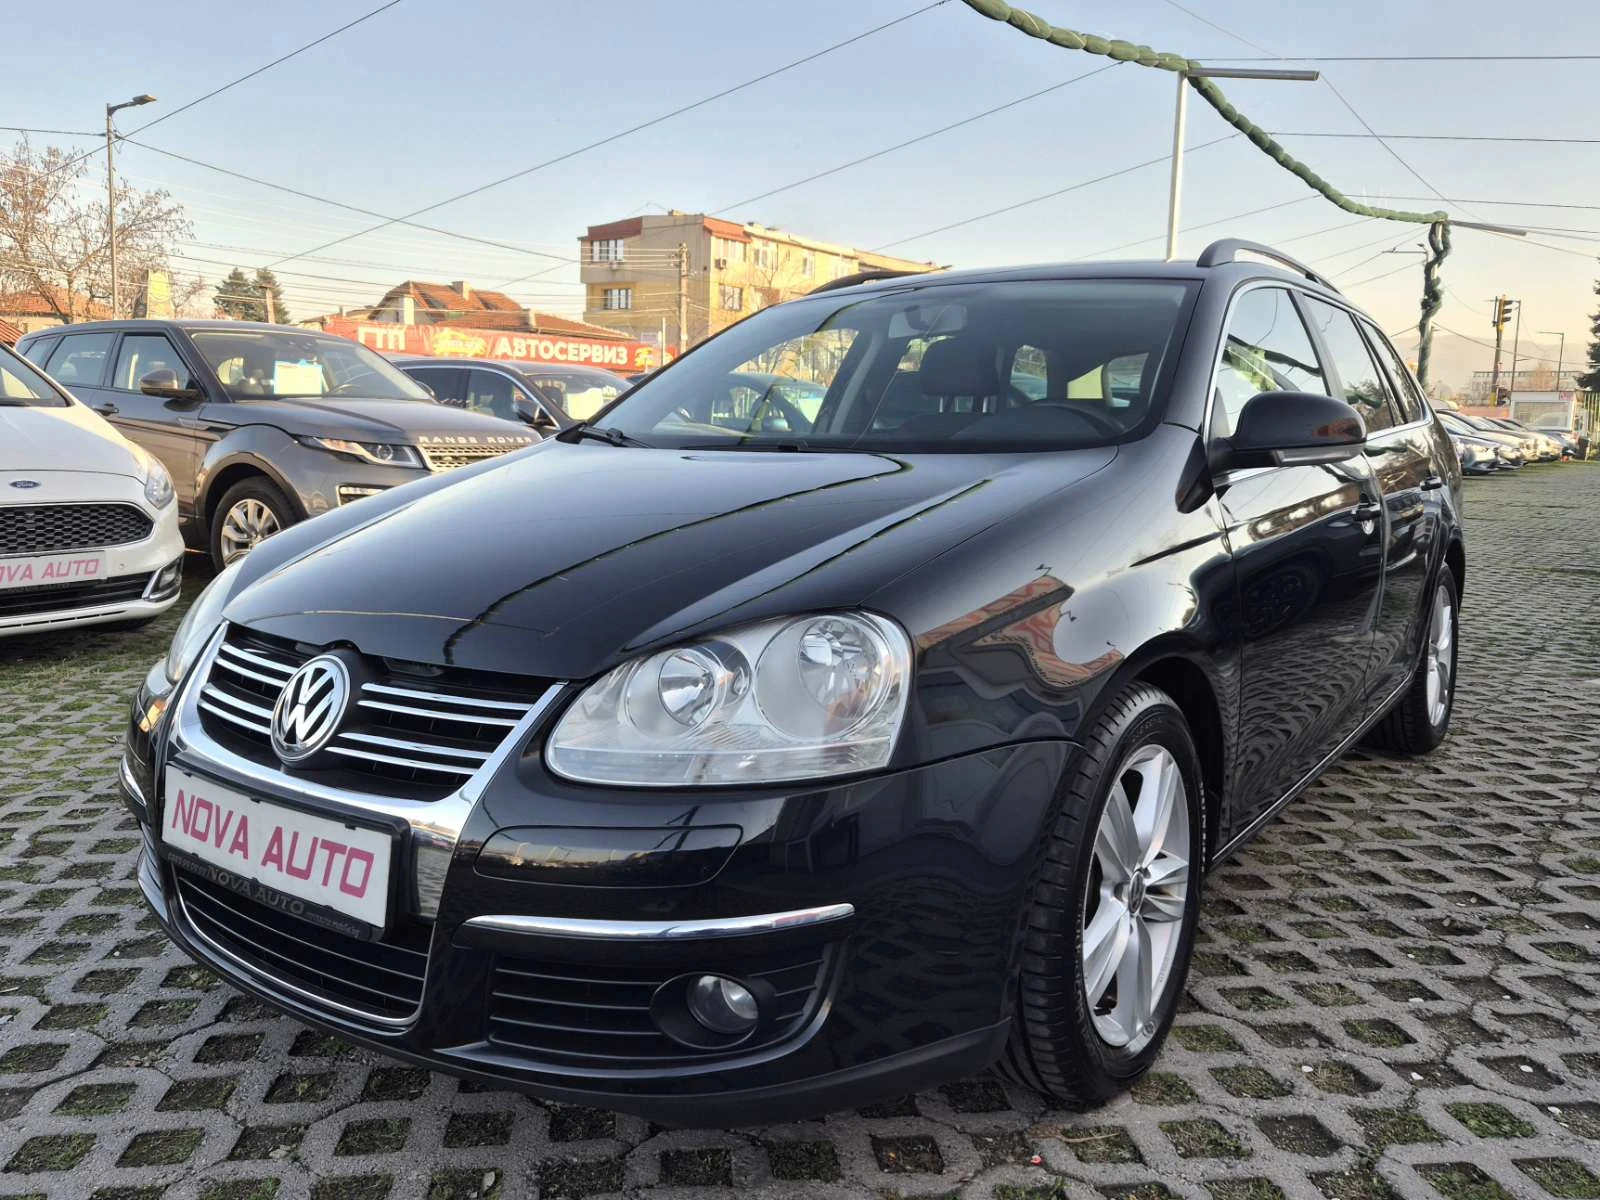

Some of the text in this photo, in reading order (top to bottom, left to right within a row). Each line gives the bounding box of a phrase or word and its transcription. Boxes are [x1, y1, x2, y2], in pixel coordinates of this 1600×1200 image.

[358, 327, 628, 365] ГТП АВТОСЕРВИЗ
[419, 436, 532, 444] RANGE ROVER
[42, 559, 100, 579] AUTO
[172, 789, 375, 899] NOVA AUTO
[207, 866, 305, 915] NOVA AUTO
